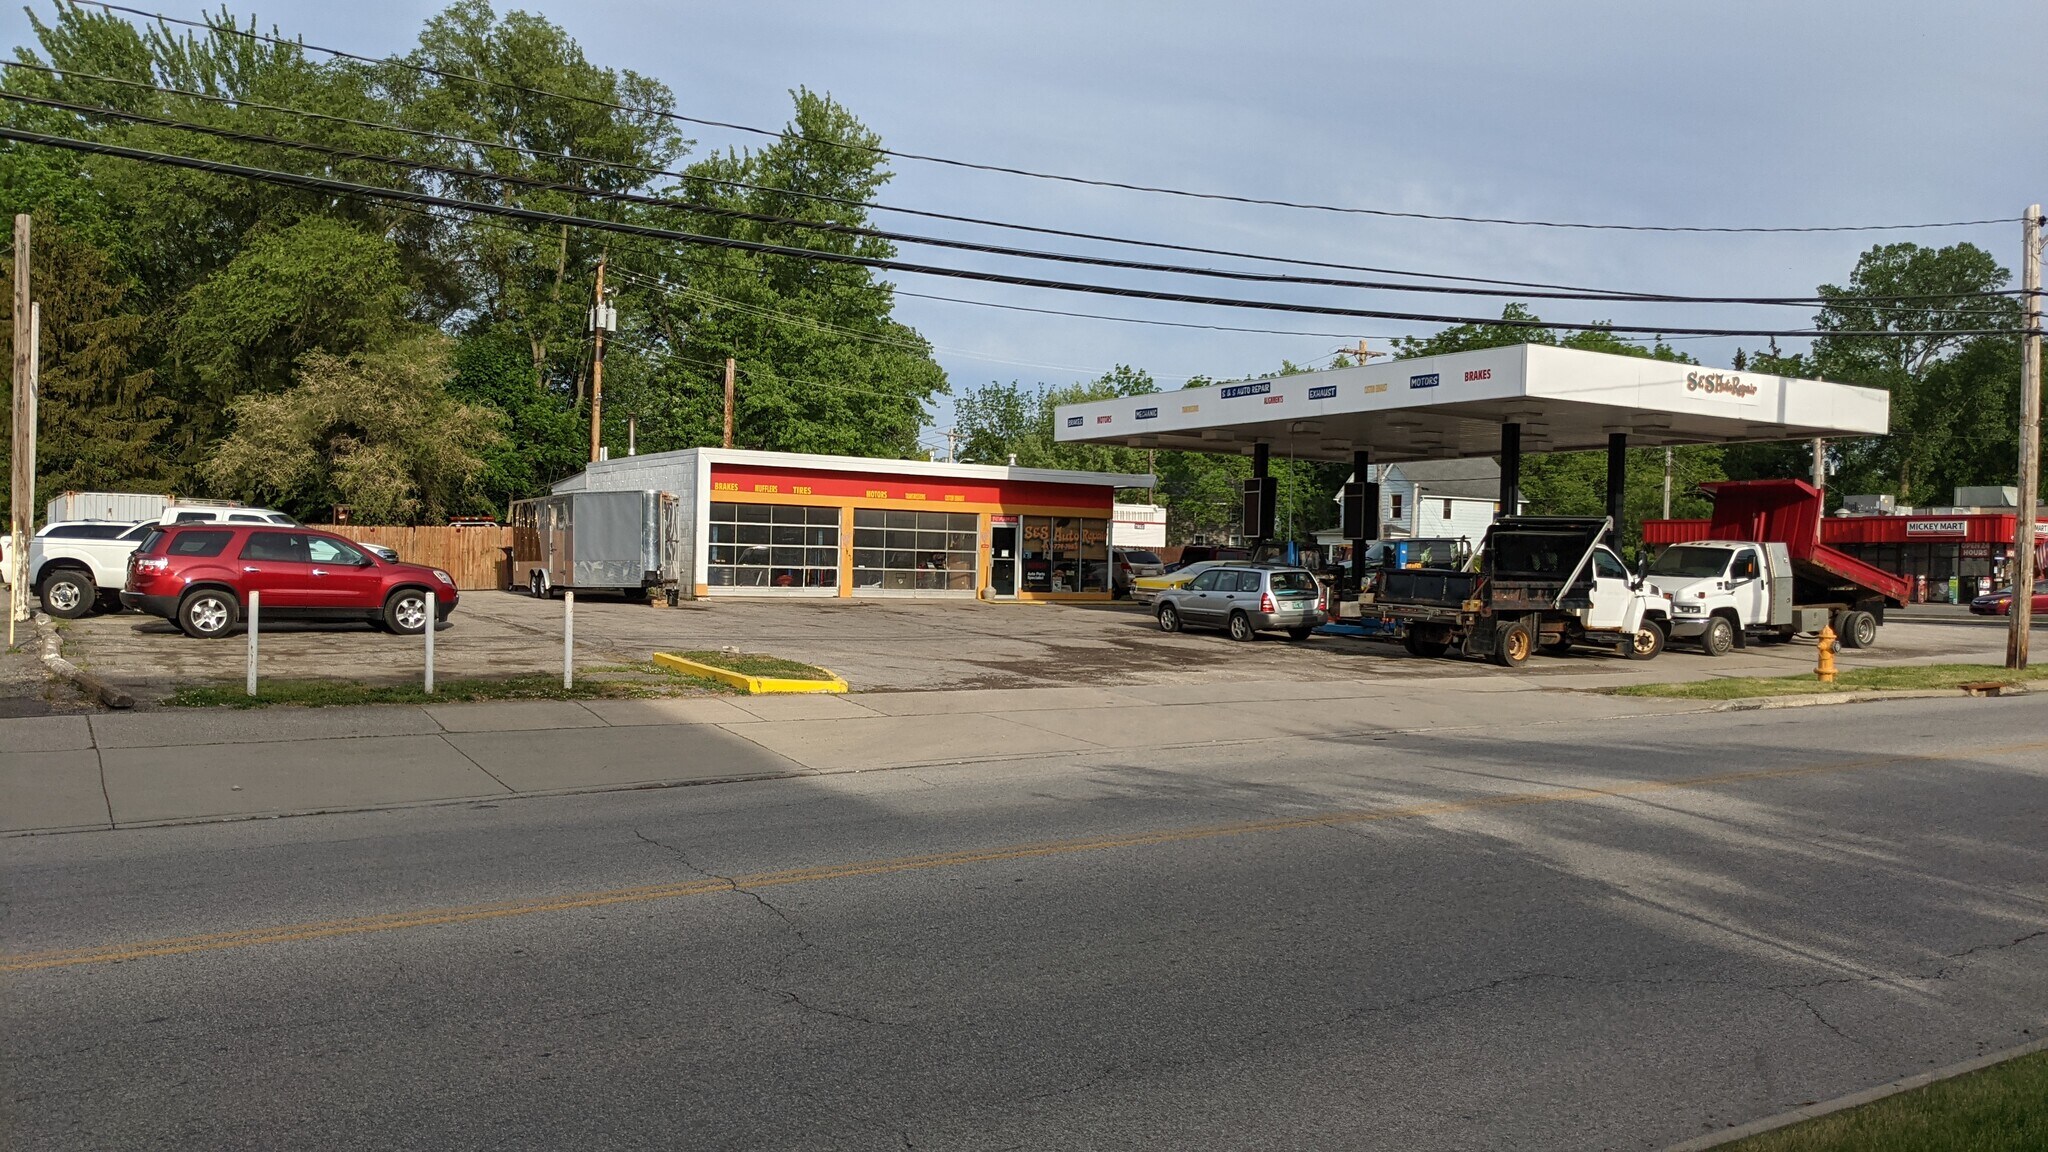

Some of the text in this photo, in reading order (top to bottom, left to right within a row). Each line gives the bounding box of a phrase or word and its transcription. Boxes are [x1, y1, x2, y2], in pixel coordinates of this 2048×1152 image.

[1410, 375, 1438, 388] MOTORS
[1464, 368, 1491, 382] BRAKES
[1236, 385, 1251, 396] AUTO
[1251, 383, 1270, 394] REPAIR
[1309, 387, 1336, 399] EXHAUST
[714, 482, 888, 499] BRAKES MUFFLERS TIRES MOTORS
[1909, 522, 1963, 530] MICKEY MART
[1024, 525, 1108, 545] S&S Auto Repair
